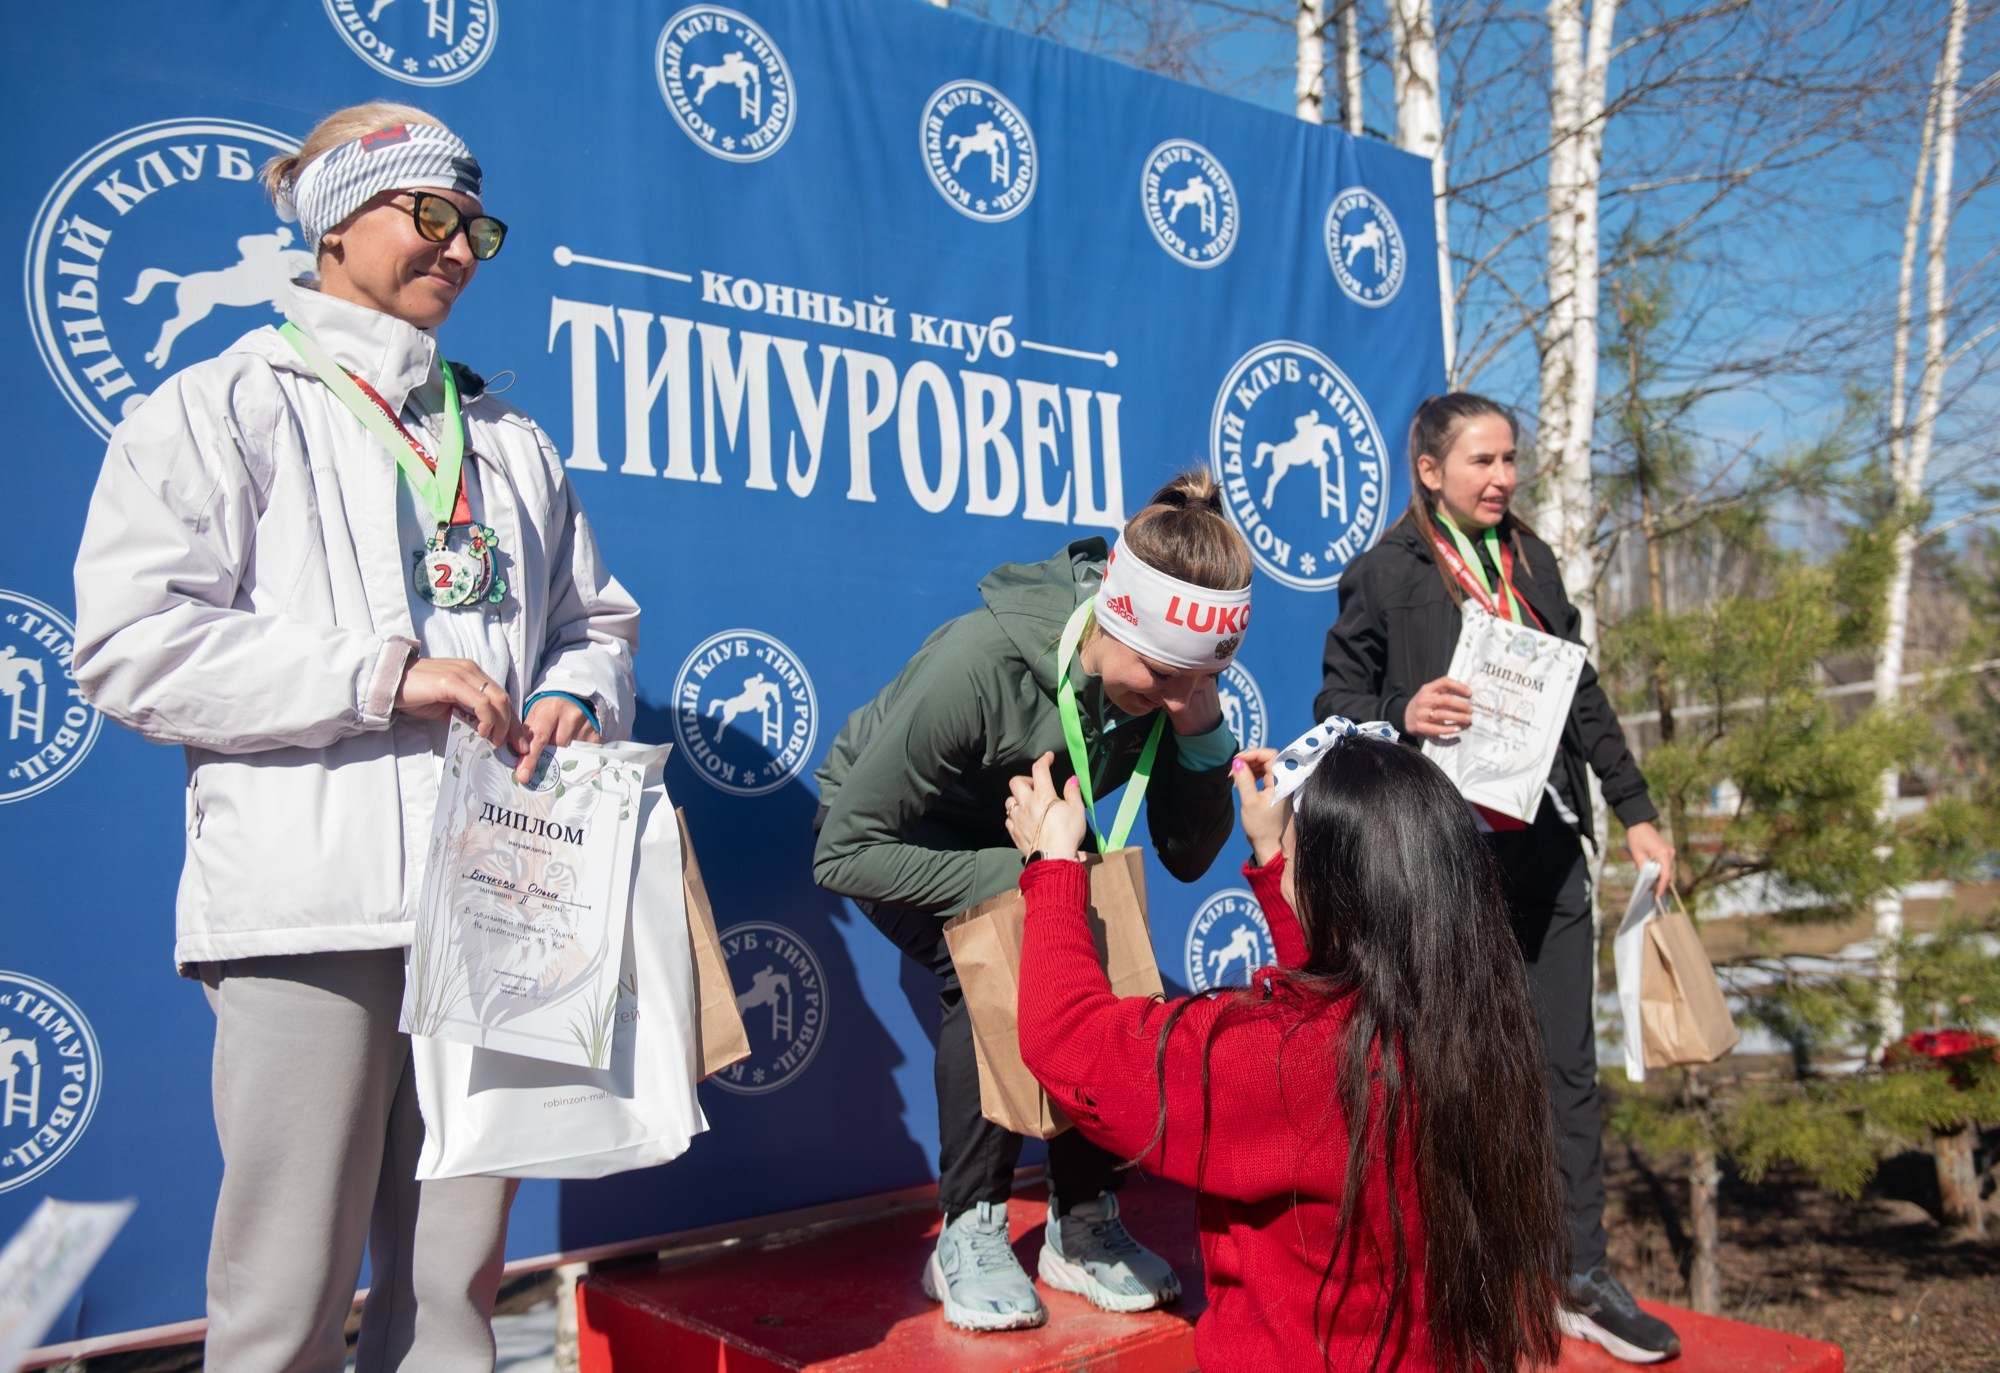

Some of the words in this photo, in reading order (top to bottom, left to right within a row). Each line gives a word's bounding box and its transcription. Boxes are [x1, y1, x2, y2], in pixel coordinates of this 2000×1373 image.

[335, 0, 395, 63] КОНН
[428, 0, 487, 73] РОВЕЦ»
[675, 15, 729, 43] КЛУБ
[666, 40, 716, 142] КОННЫЙ
[937, 89, 982, 117] КЛУБ
[93, 144, 254, 216] КЛУБ
[57, 214, 149, 420] ННЫЙ
[1235, 357, 1300, 411] КЛУБ
[548, 296, 1126, 532] ТИМУРОВЕЦ
[1222, 411, 1291, 567] КОННЫЙ
[434, 563, 453, 588] 2
[1106, 600, 1138, 627] adidas
[1165, 595, 1250, 635] LUKO
[693, 640, 750, 679] КЛУБ
[1481, 662, 1545, 693] ДИПЛОМ
[6, 611, 89, 781] «ТИМРОВЕЦ»
[682, 681, 736, 781] КОННЫЙ
[479, 801, 585, 846] ДИПЛОМ
[527, 883, 559, 899] Ольга
[0, 990, 86, 1168] «ТИМУРОВЕЦ»
